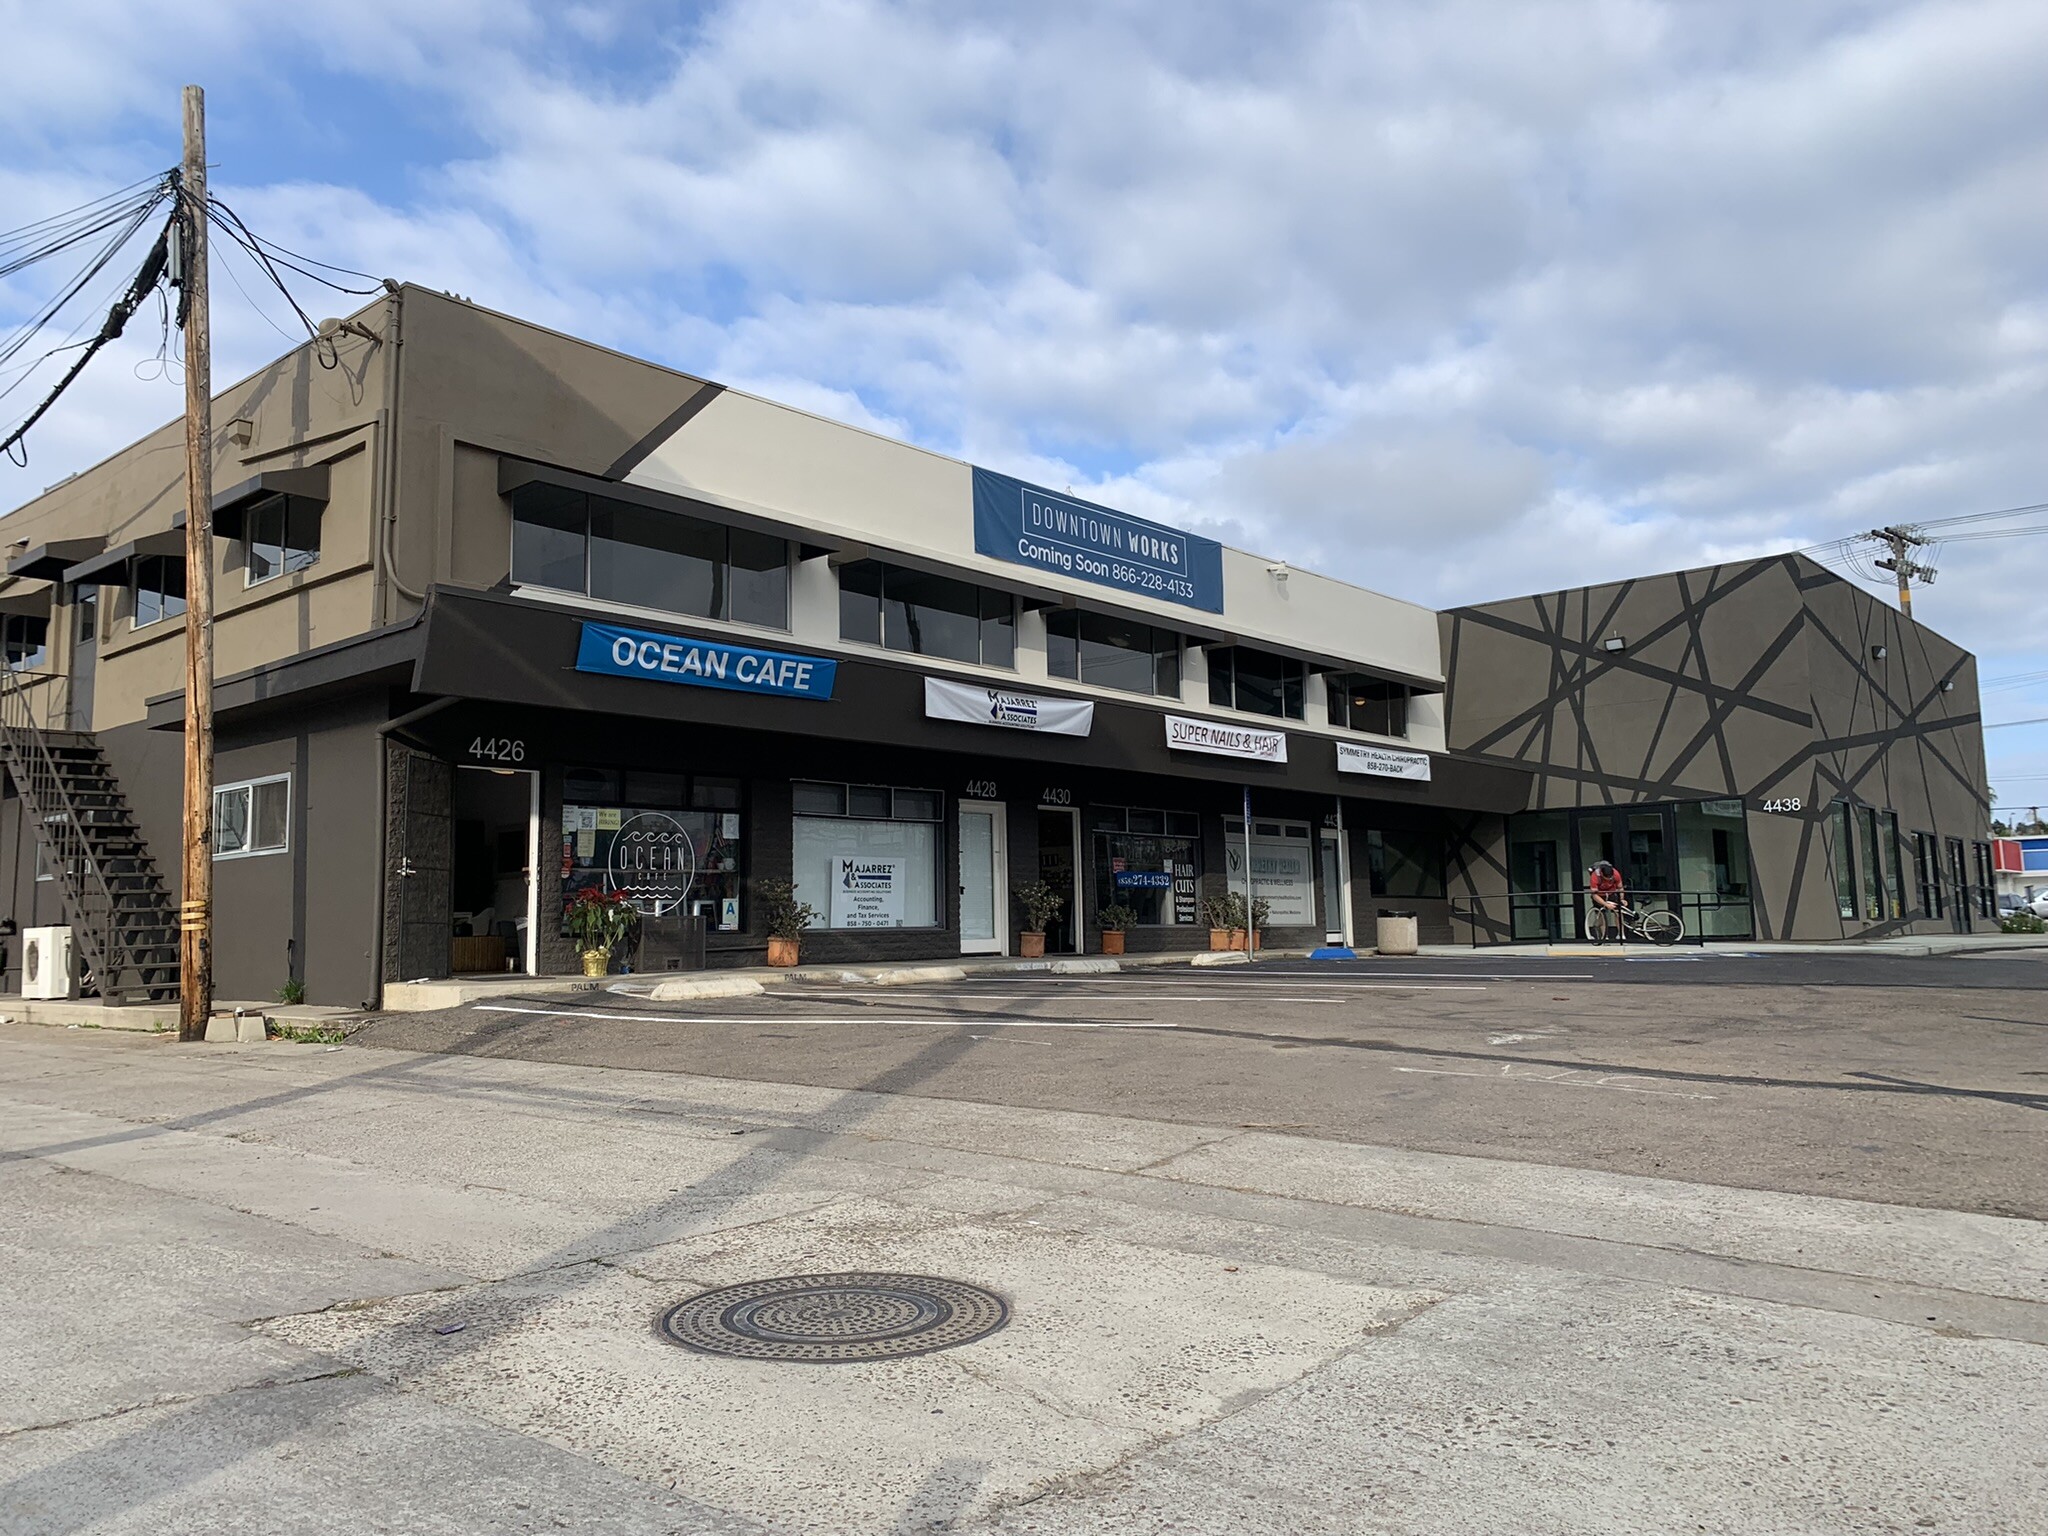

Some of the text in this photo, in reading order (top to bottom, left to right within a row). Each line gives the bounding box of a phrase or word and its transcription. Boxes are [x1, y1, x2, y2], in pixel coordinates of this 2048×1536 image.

[1032, 502, 1179, 565] DOWNTOWN WORKS
[1018, 538, 1194, 599] Coming Soon 866-228-4133
[611, 636, 814, 691] OCEAN CAFE
[998, 703, 1005, 712] &
[1000, 711, 1037, 725] ASSOCIATES
[1172, 723, 1279, 753] SUPER NAILS & HAIR
[468, 736, 525, 762] 4426
[1339, 746, 1428, 766] SYMMETRY HEALTH CHIROPRACTIC
[1366, 761, 1404, 773] 858-270-BACK
[966, 779, 997, 798] 4428
[1042, 787, 1071, 804] 4430
[1762, 797, 1801, 813] 4438
[620, 845, 685, 871] OCEAN
[842, 859, 892, 874] MAJARREZ
[1174, 863, 1195, 877] HAIR
[638, 872, 668, 881] CAFE
[851, 872, 857, 881] &
[854, 881, 892, 889] ASSOCIATES
[1174, 879, 1195, 893] CUTS
[853, 896, 884, 904] Accounting,
[726, 902, 735, 915] A
[571, 982, 600, 991] PALM
